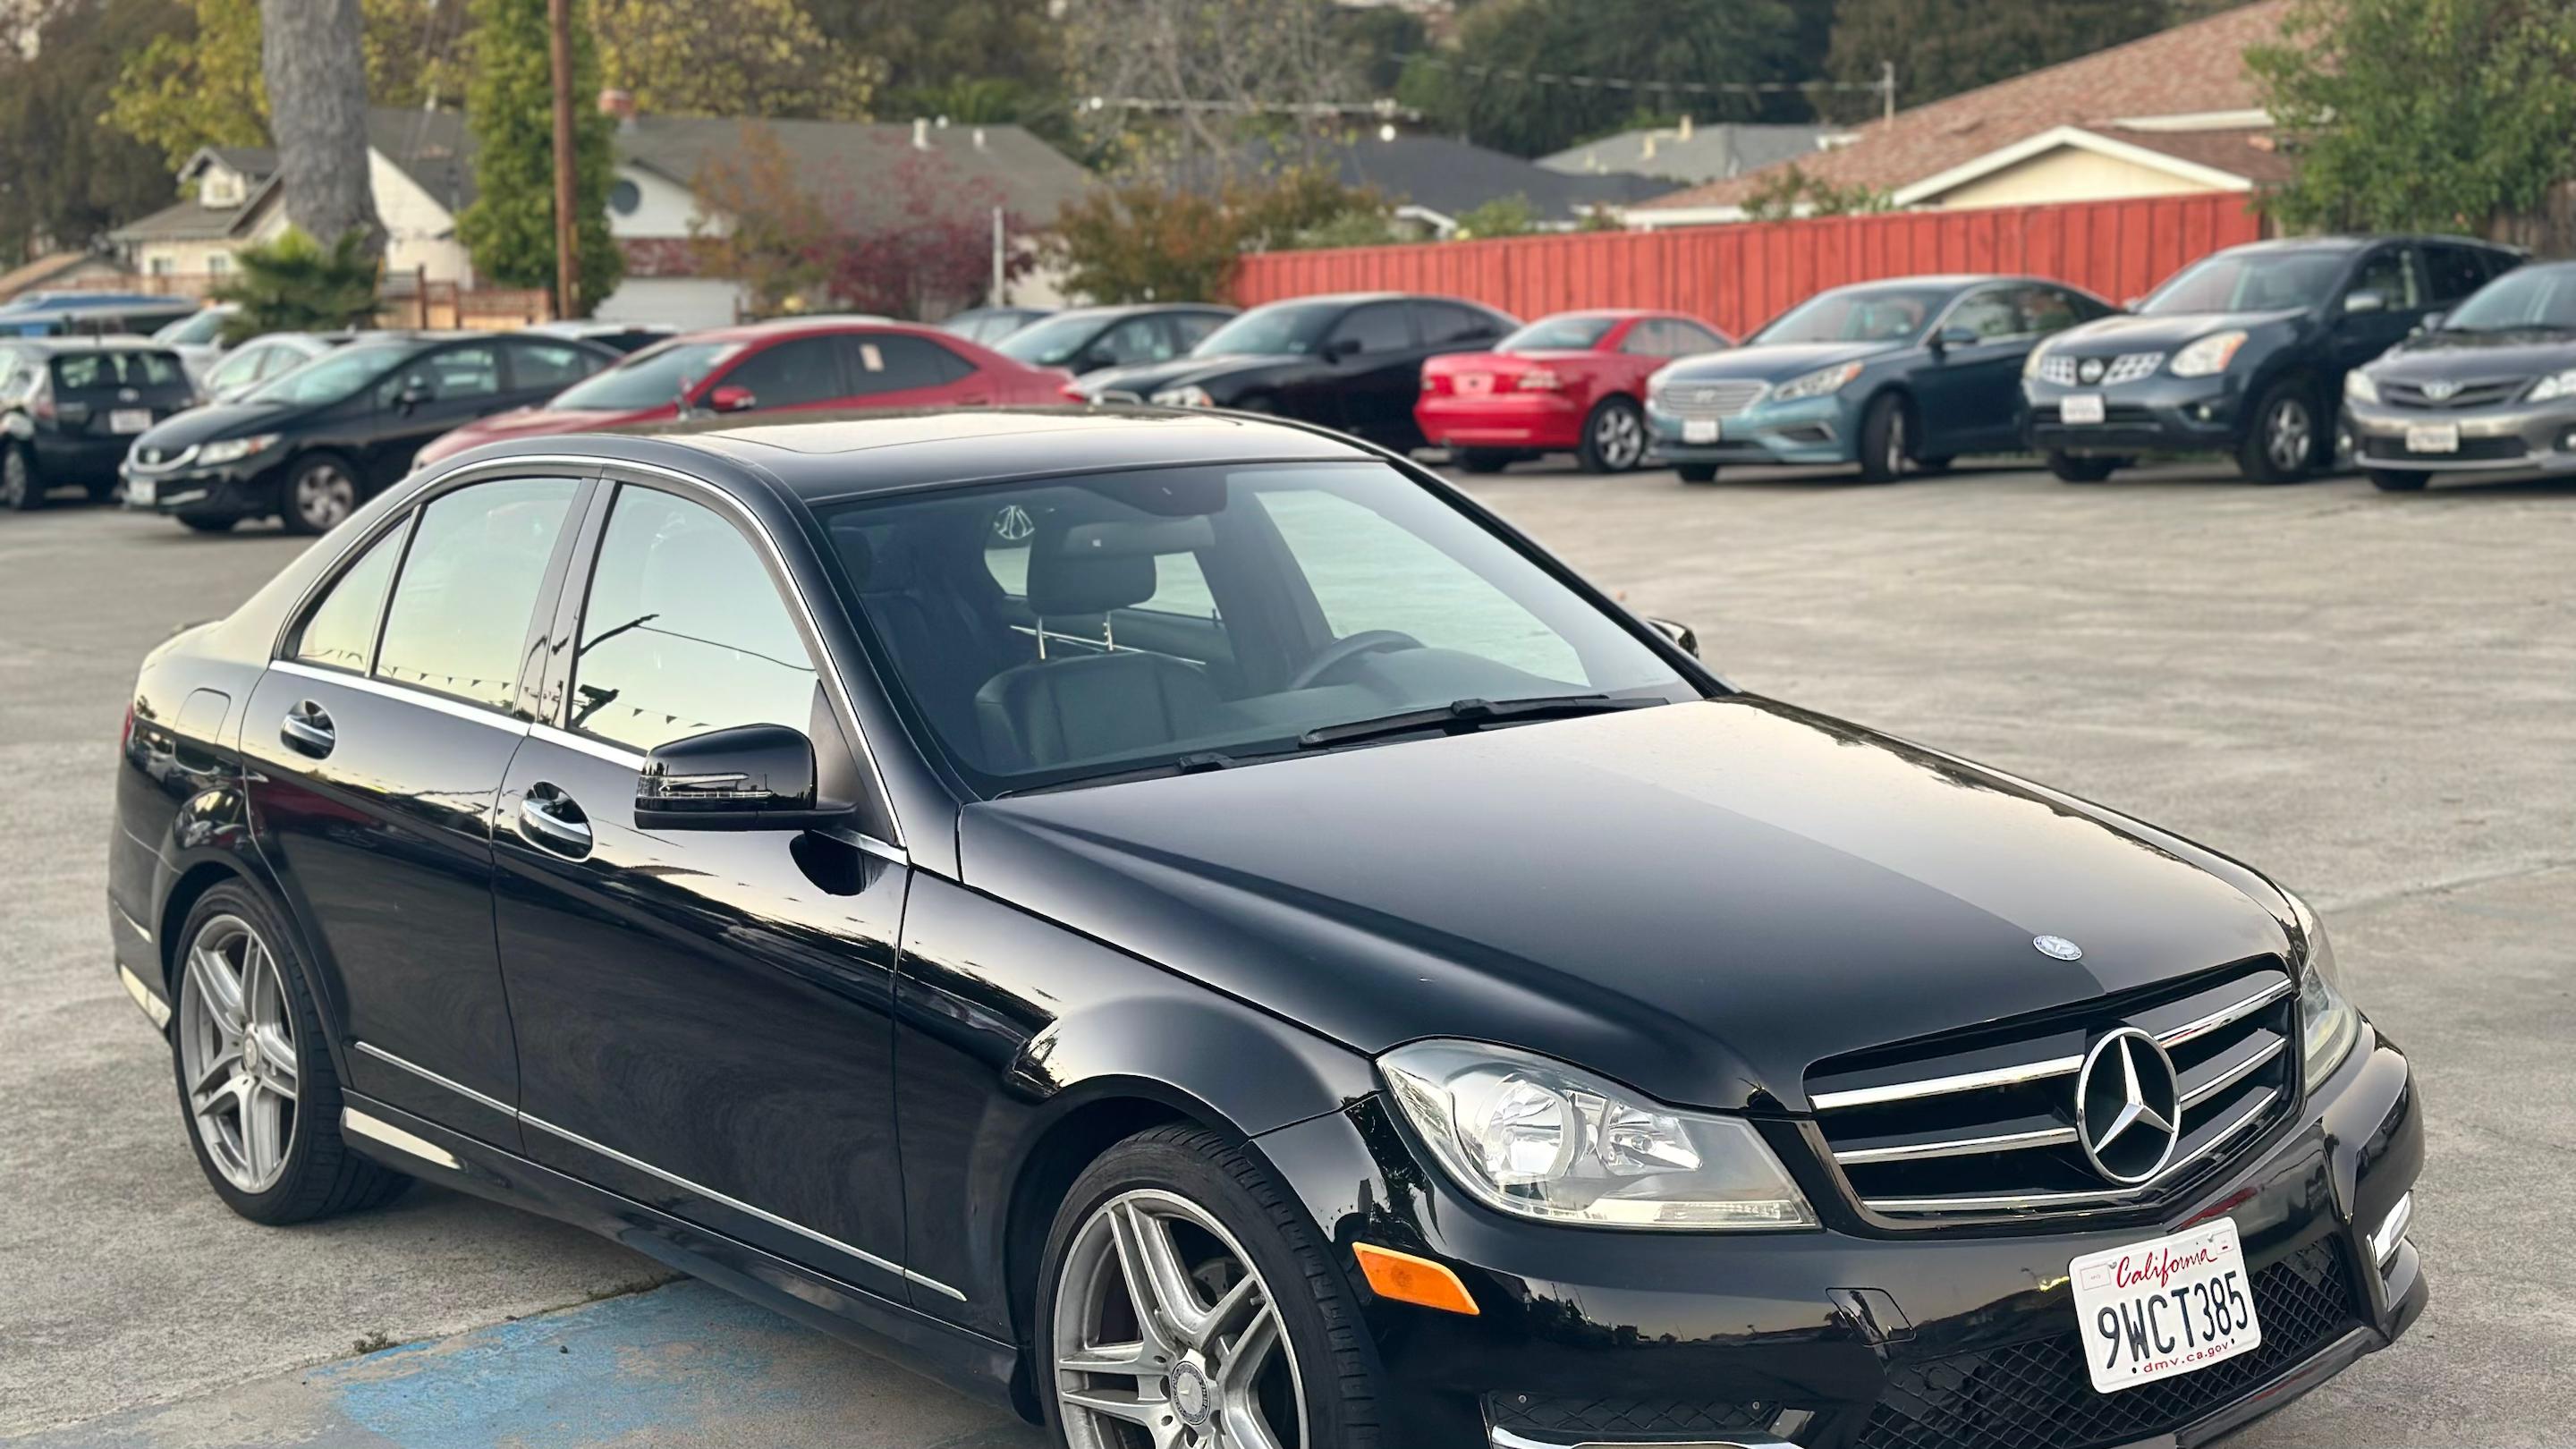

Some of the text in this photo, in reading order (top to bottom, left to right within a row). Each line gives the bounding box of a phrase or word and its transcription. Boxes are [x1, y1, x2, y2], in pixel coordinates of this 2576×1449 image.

[2116, 1247, 2217, 1288] California
[2097, 1270, 2248, 1369] 9WCT385
[2143, 1340, 2229, 1374] dmv.ca.gov
